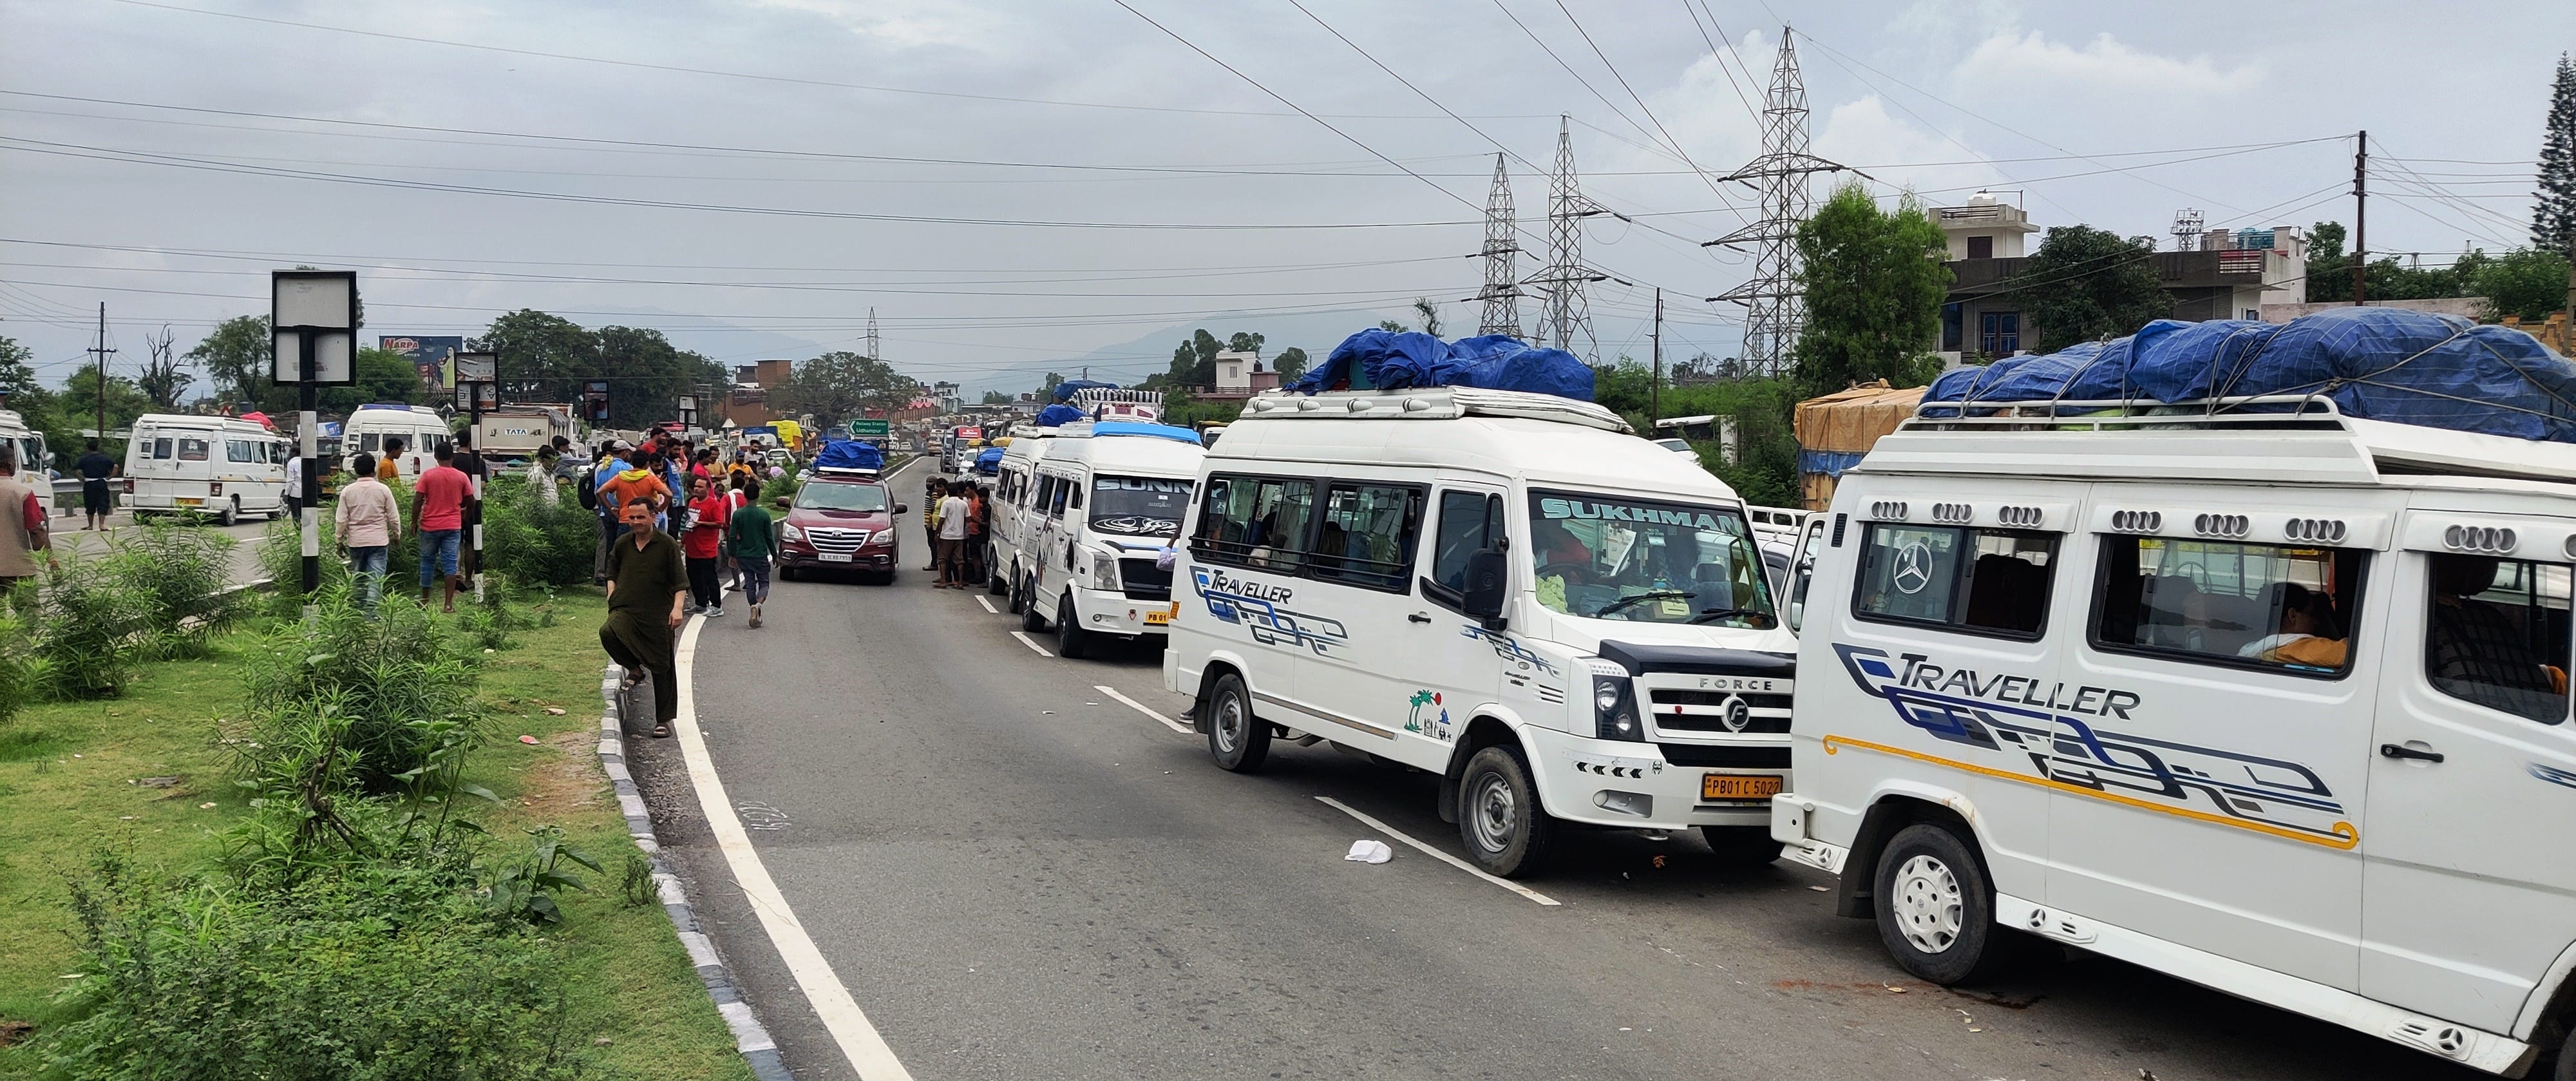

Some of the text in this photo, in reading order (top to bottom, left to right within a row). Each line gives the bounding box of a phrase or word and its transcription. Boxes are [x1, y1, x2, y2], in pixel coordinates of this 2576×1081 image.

[383, 338, 419, 352] NARPA
[1541, 498, 1741, 535] SUKHMAN
[1211, 569, 1293, 605] TRAVELLER
[1700, 678, 1772, 691] FORCE
[1899, 653, 2141, 720] TRAVELLER
[1743, 780, 1750, 794] C
